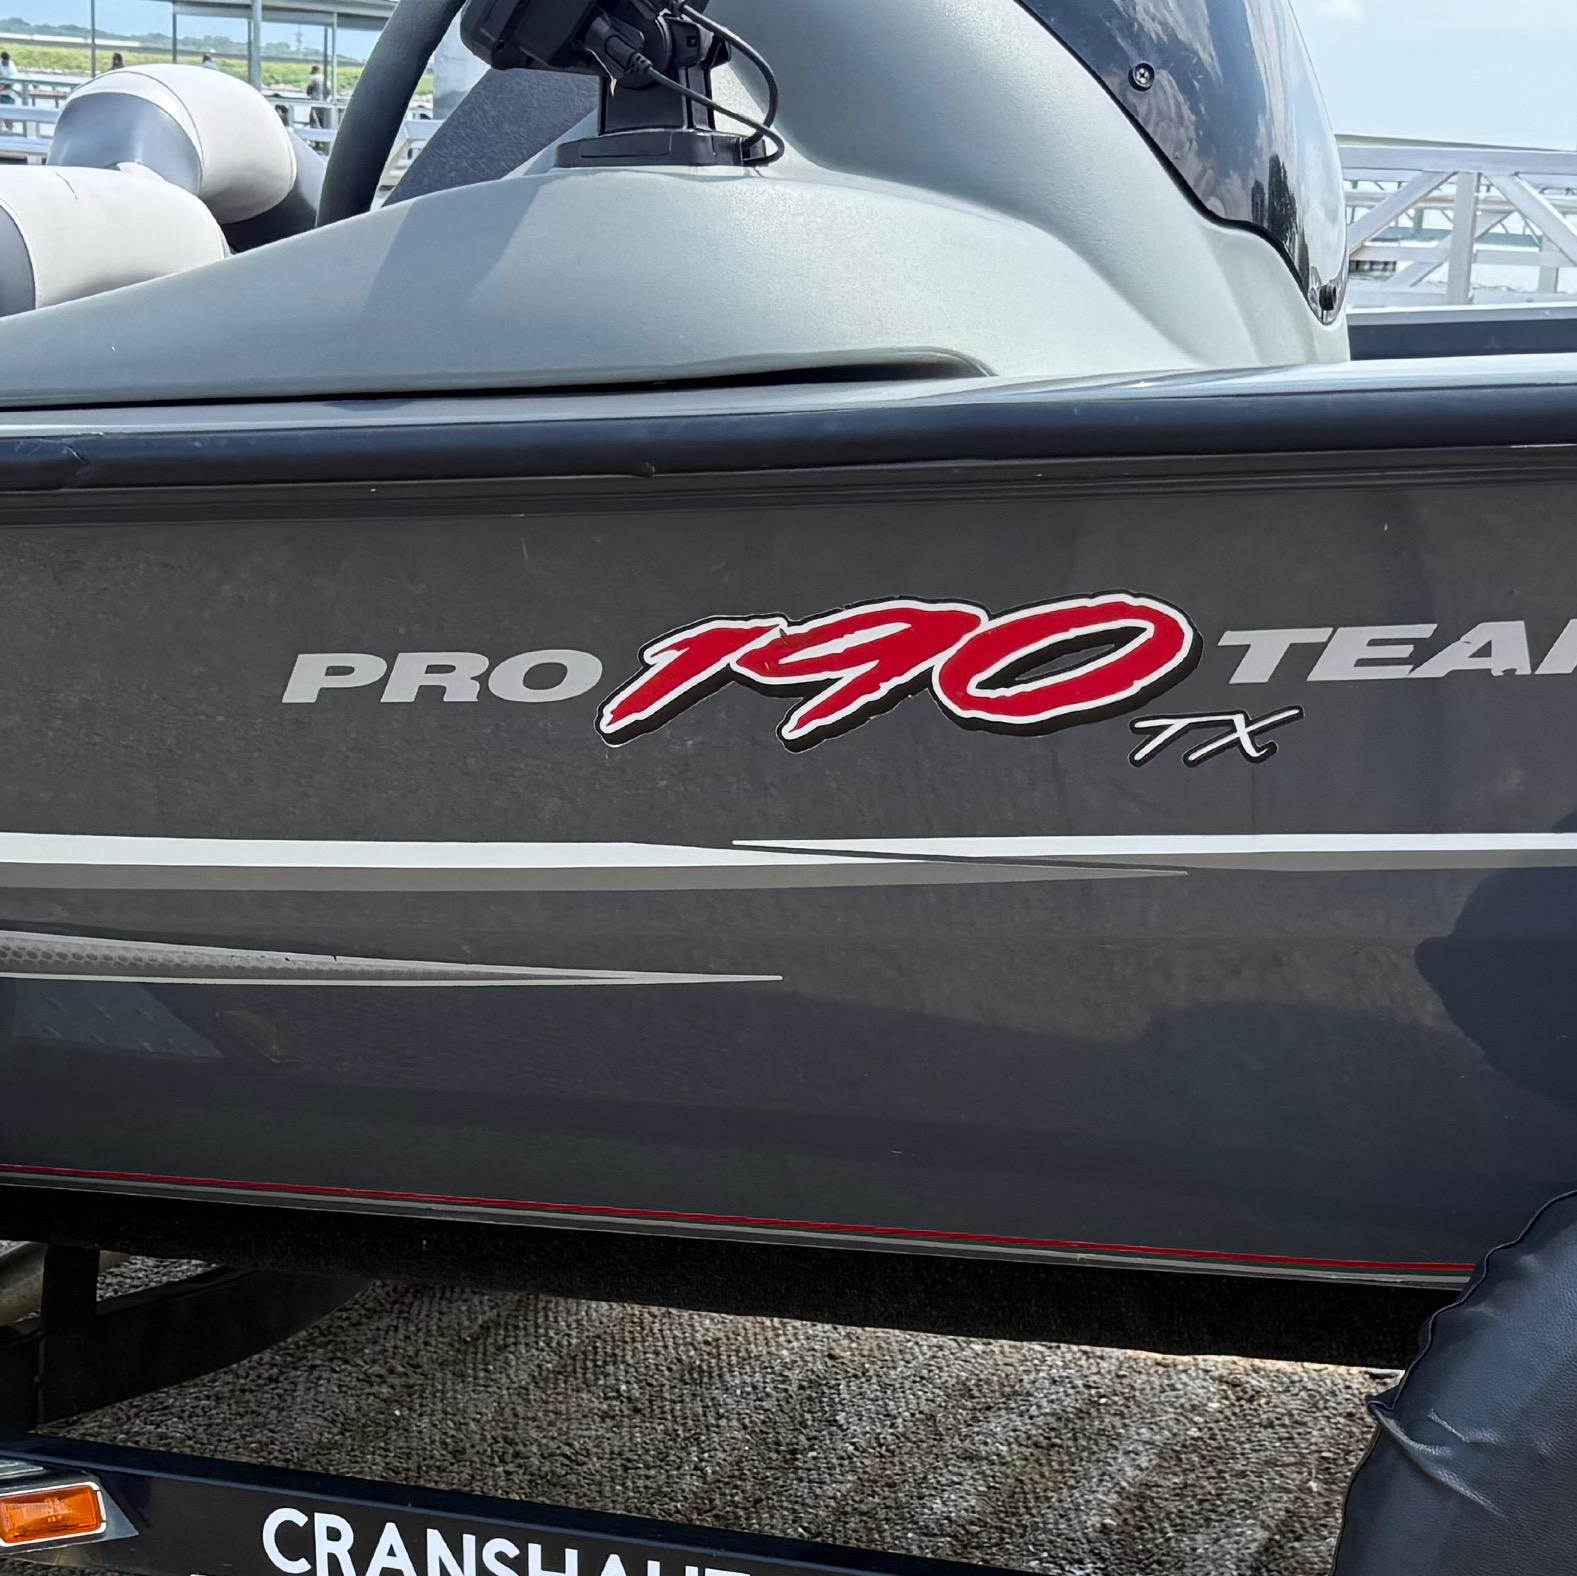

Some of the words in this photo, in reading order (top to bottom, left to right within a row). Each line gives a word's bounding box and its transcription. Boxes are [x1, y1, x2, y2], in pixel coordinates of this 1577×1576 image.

[281, 649, 604, 704] PRO
[596, 592, 1201, 752] 190
[1128, 705, 1303, 764] TX
